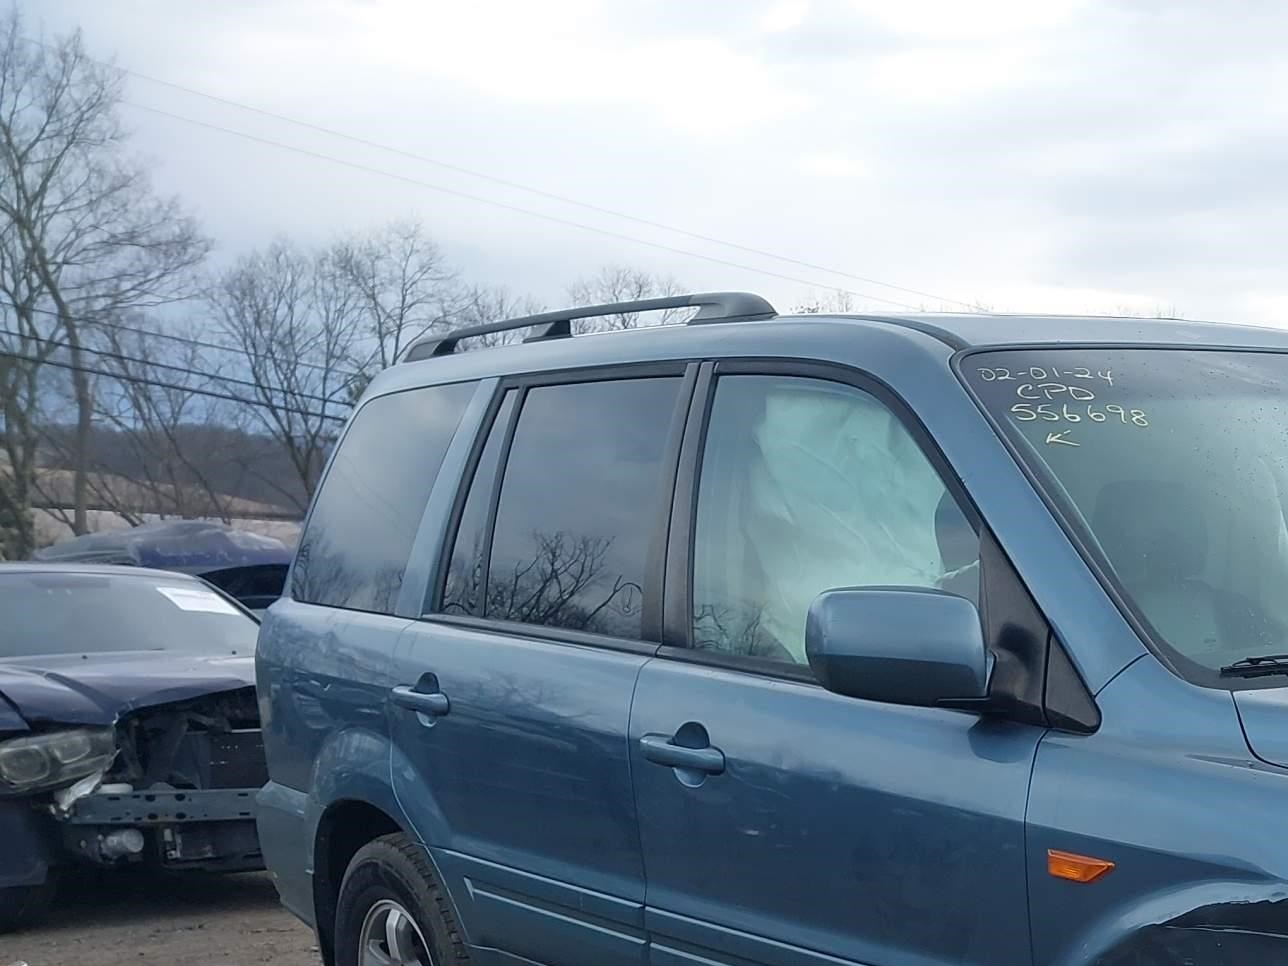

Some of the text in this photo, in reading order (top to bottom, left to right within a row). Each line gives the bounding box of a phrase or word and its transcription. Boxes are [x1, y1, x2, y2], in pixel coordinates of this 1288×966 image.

[976, 367, 1115, 386] 02-01-24
[1017, 383, 1095, 400] CPD
[1011, 403, 1148, 426] 556698
